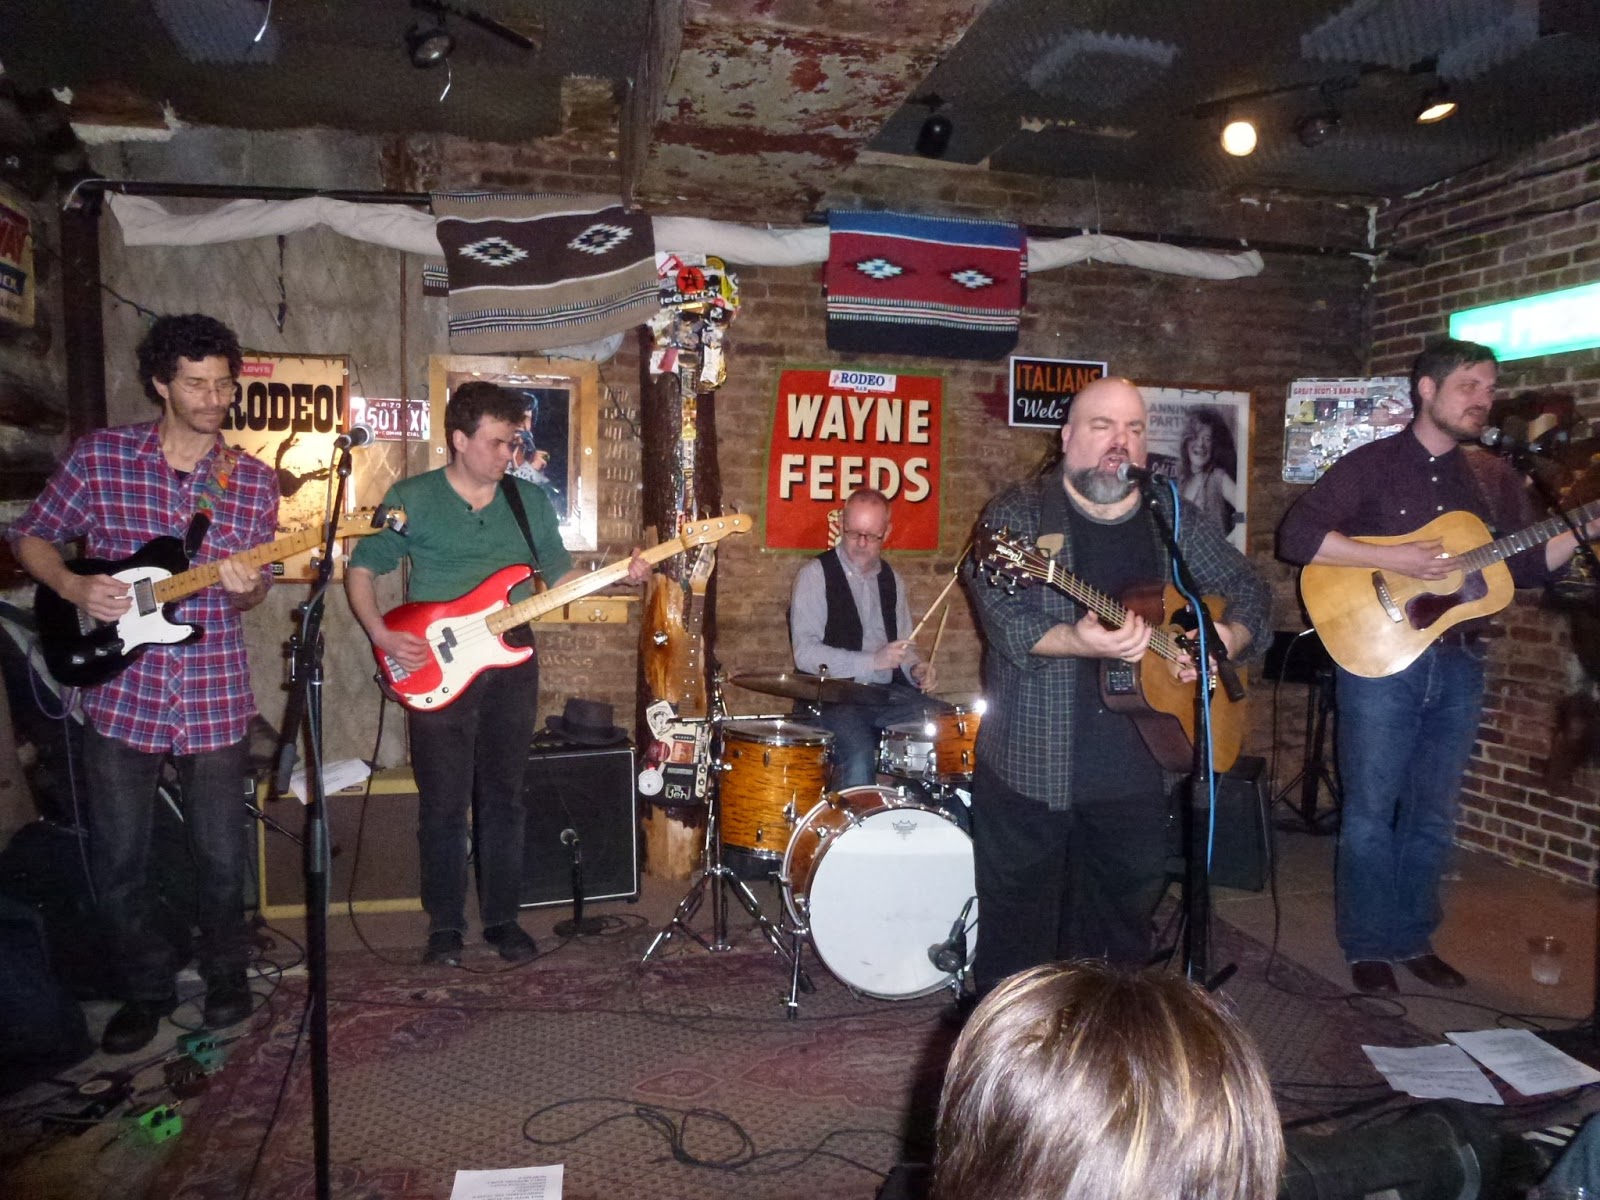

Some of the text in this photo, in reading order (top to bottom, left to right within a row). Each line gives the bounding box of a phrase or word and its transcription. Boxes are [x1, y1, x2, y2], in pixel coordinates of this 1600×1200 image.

[841, 372, 885, 387] RODEO
[1016, 364, 1100, 394] ITALIANS
[787, 393, 930, 444] WAYNE
[1017, 397, 1064, 420] Welc
[779, 453, 931, 503] FEEDS
